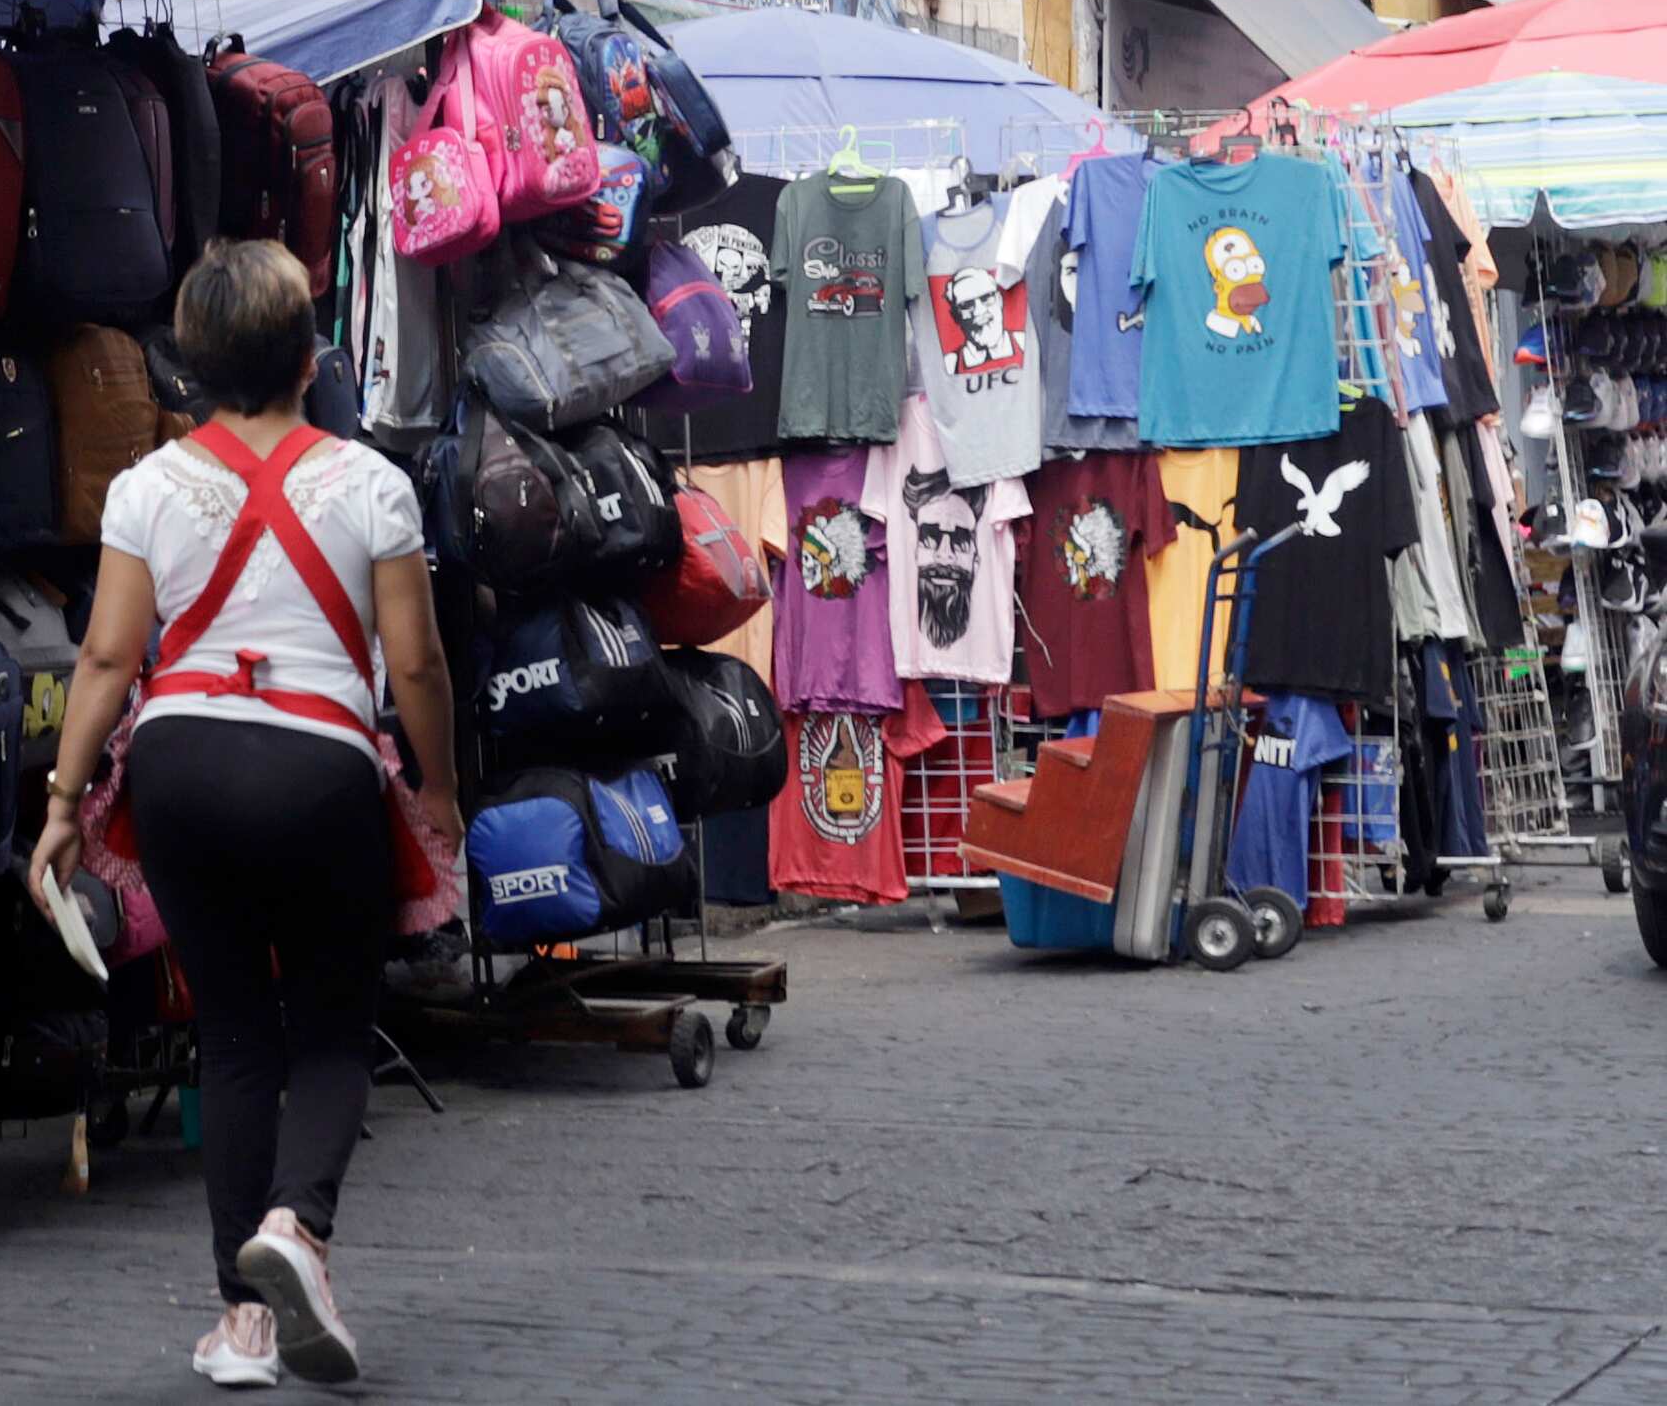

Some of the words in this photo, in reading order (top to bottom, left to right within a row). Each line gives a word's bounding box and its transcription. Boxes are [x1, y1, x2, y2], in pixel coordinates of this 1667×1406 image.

[1187, 214, 1210, 233] NO
[1218, 208, 1270, 226] BRAIN
[965, 365, 1020, 395] UFC
[487, 657, 561, 712] SPORT
[489, 869, 570, 897] SPORT
